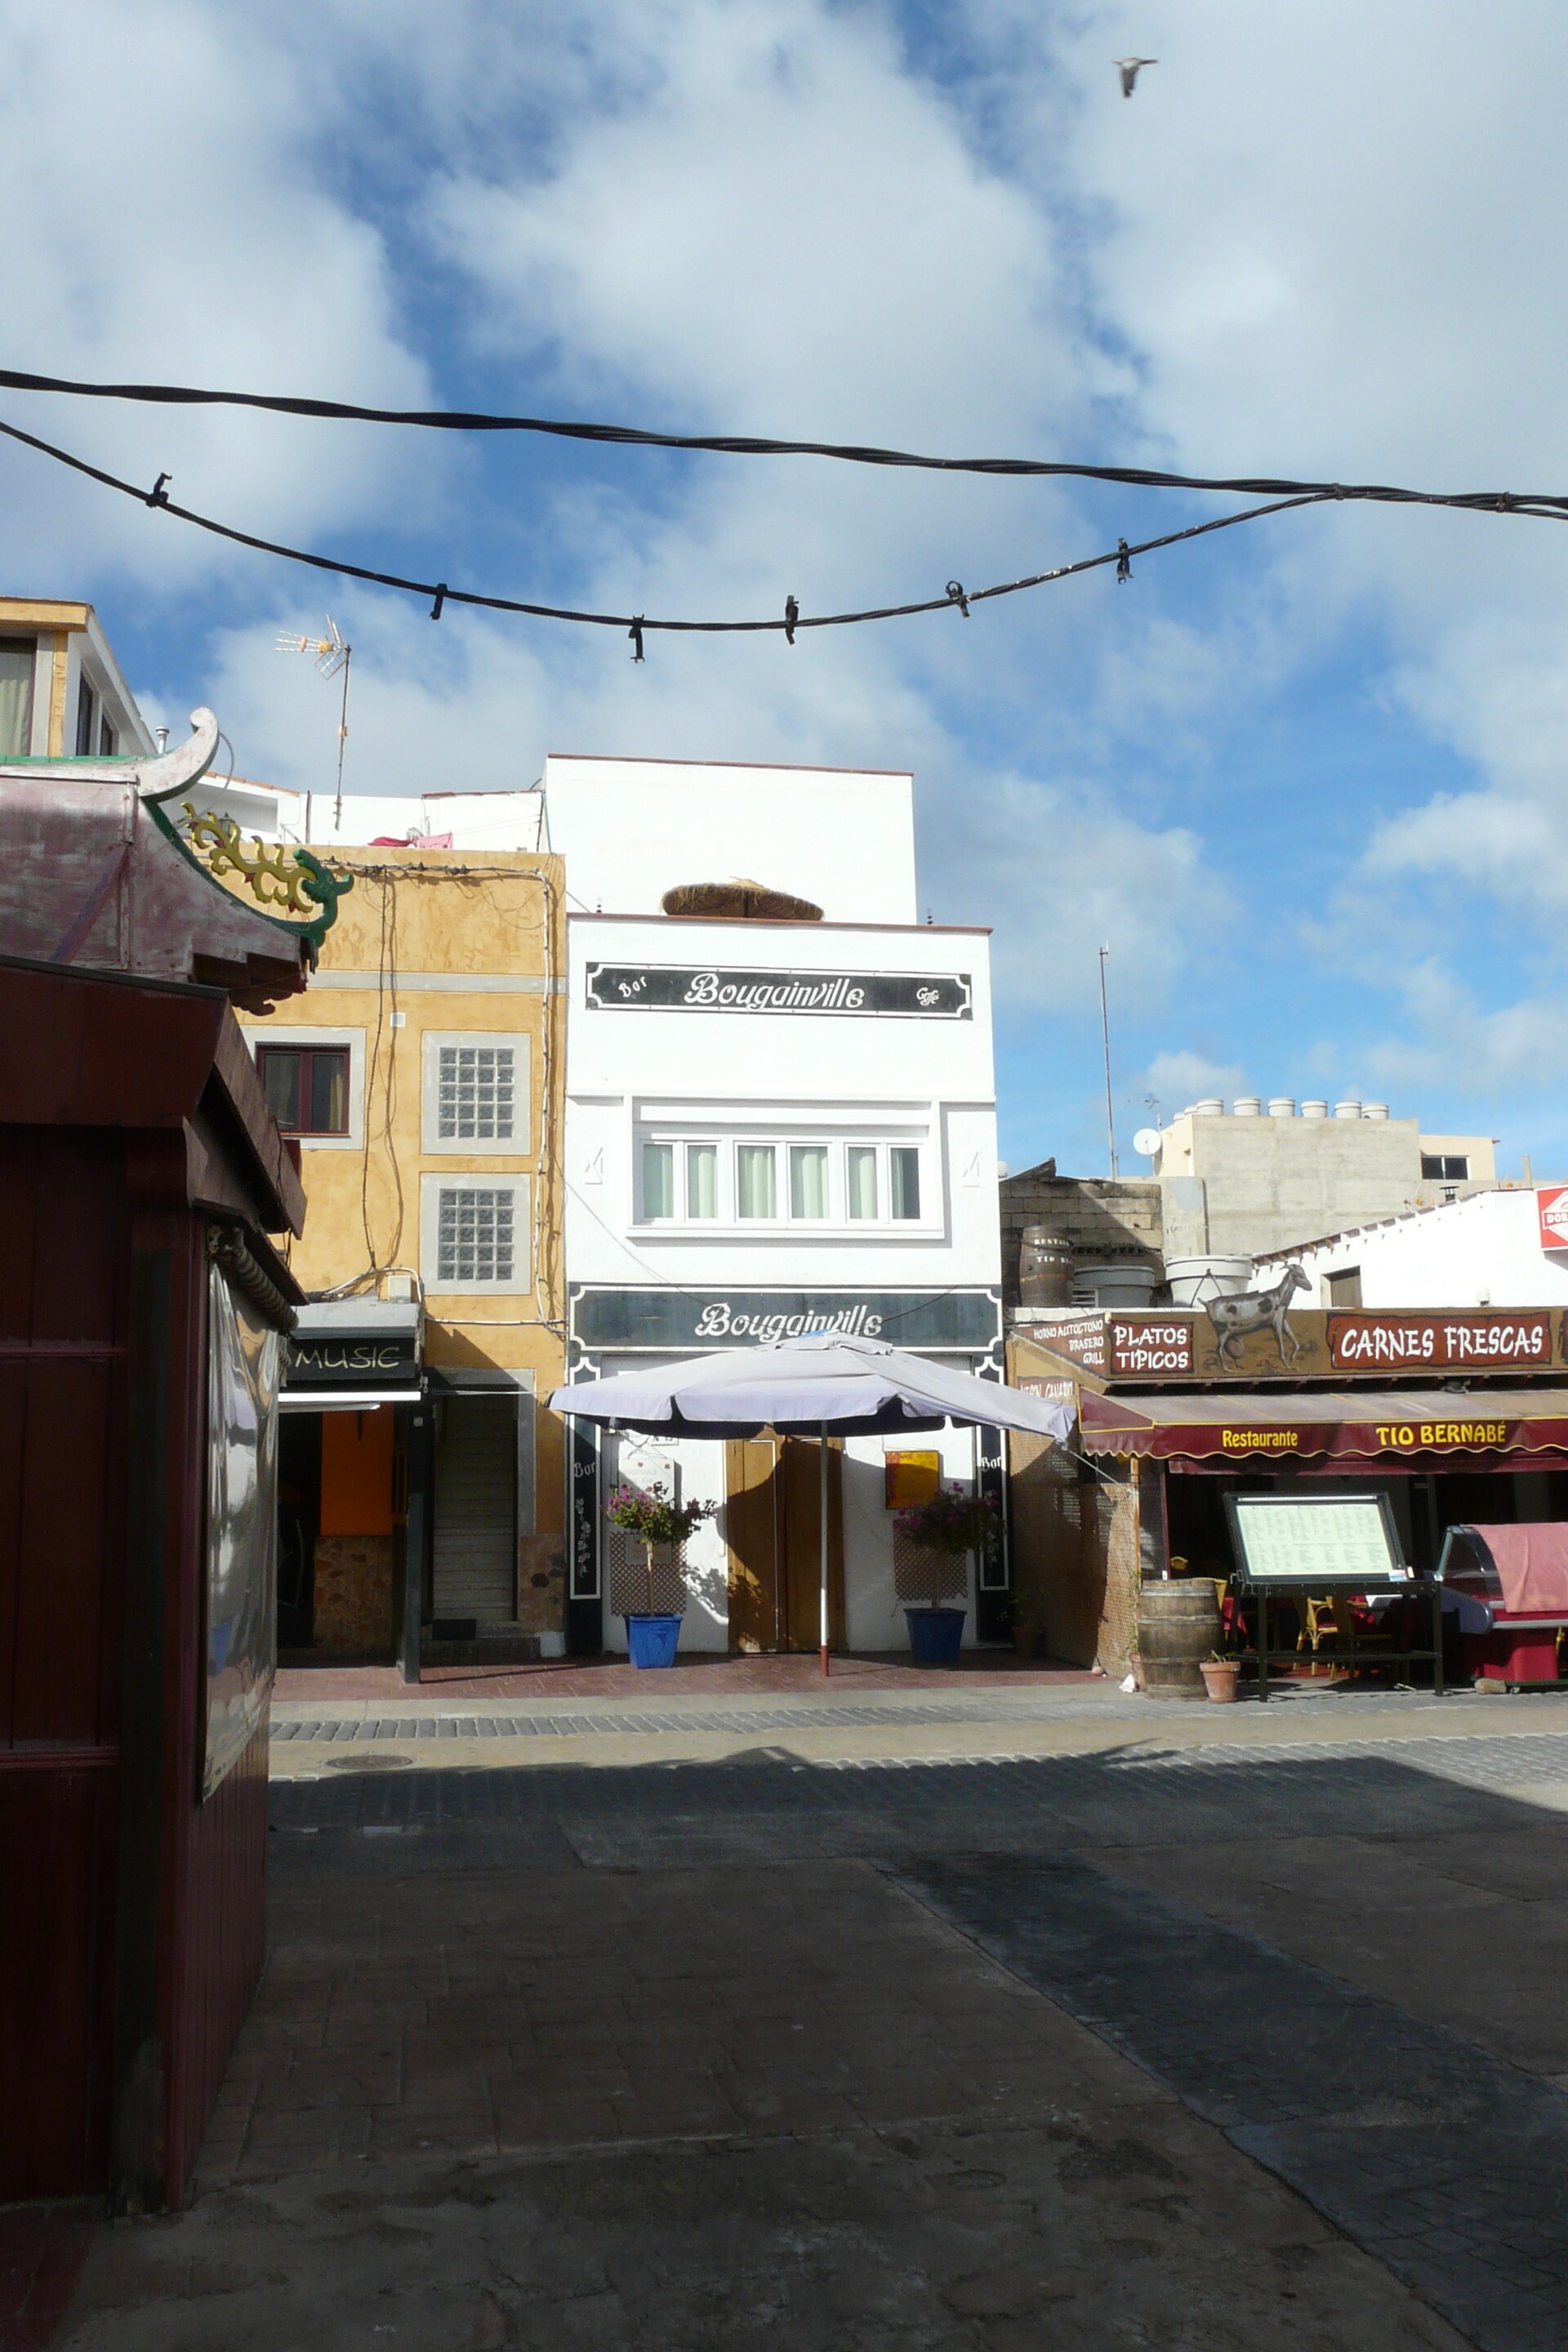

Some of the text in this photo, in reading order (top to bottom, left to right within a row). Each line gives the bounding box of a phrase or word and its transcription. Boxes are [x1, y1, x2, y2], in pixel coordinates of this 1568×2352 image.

[618, 976, 648, 998] Bar
[684, 973, 865, 1011] Bougainville
[695, 1302, 883, 1343] Bougainville
[1033, 1319, 1103, 1340] HORNO AUTOCTONO
[1068, 1336, 1104, 1352] BRASERO
[1113, 1325, 1187, 1347] PLATOS
[1340, 1325, 1543, 1361] CARNES FRESCAS
[295, 1347, 400, 1369] MUSIC
[1083, 1352, 1105, 1365] GRILL
[1116, 1348, 1189, 1370] TIPICOS
[1222, 1430, 1298, 1448] Restaurante
[1375, 1420, 1507, 1446] TIO BERNABÉ
[573, 1461, 596, 1478] Bar
[981, 1456, 1003, 1472] Bar
